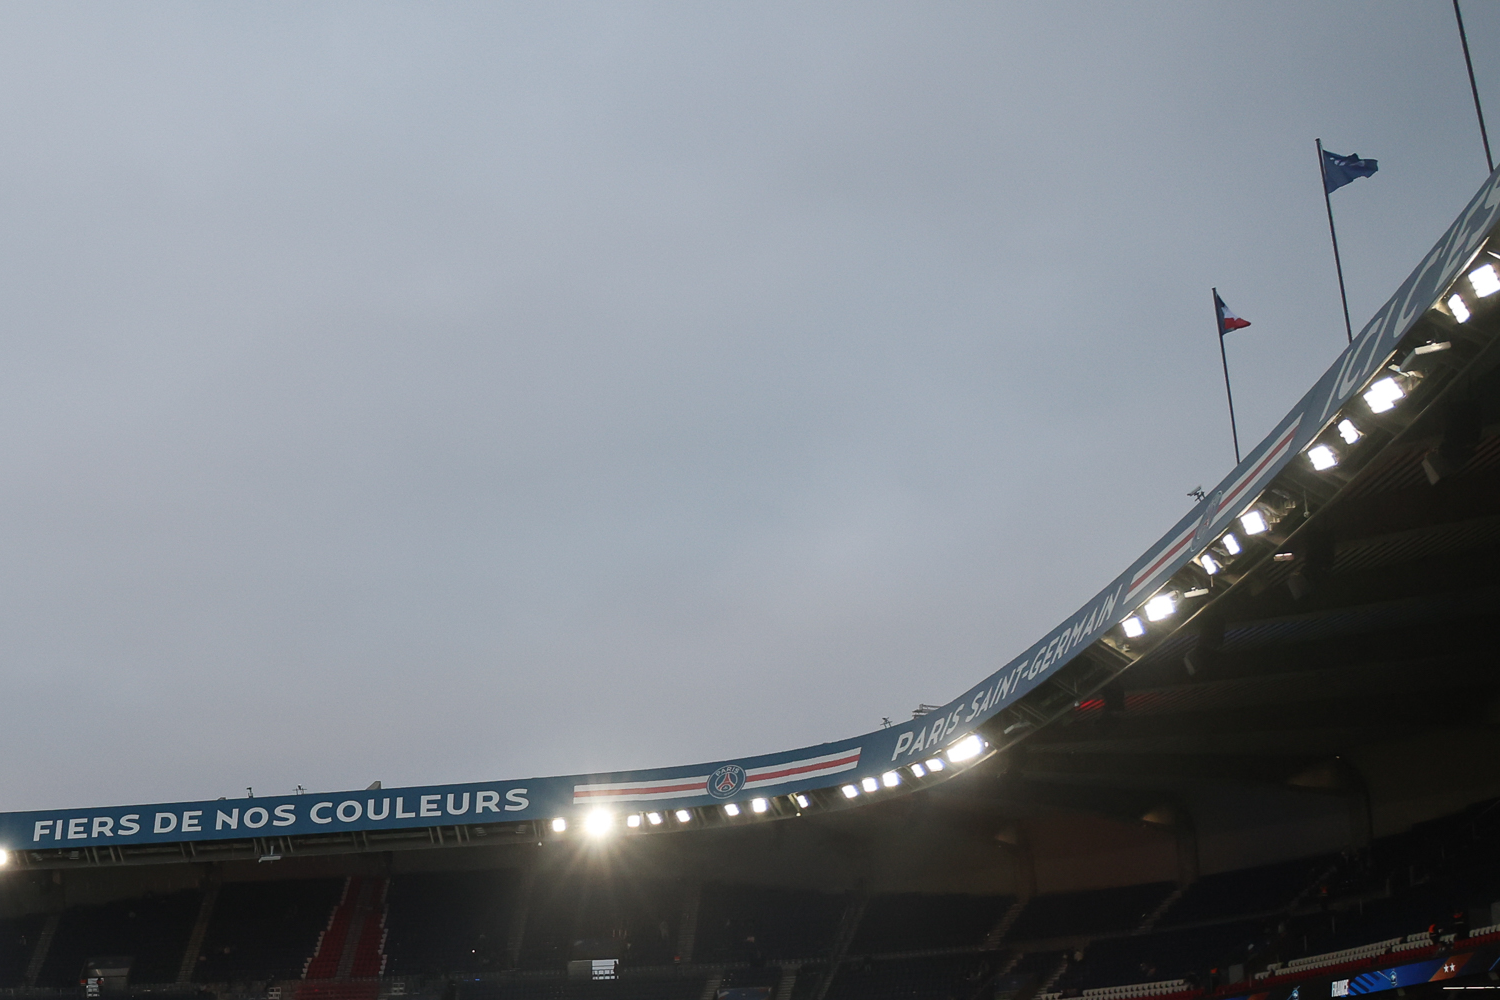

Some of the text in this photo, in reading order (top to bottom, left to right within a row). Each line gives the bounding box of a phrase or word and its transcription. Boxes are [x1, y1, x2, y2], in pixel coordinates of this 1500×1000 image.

[891, 583, 1124, 762] PARIS SAINT-GERMAIN
[715, 766, 740, 777] PARIS
[32, 788, 530, 842] FIERS DE NOS COULEURS
